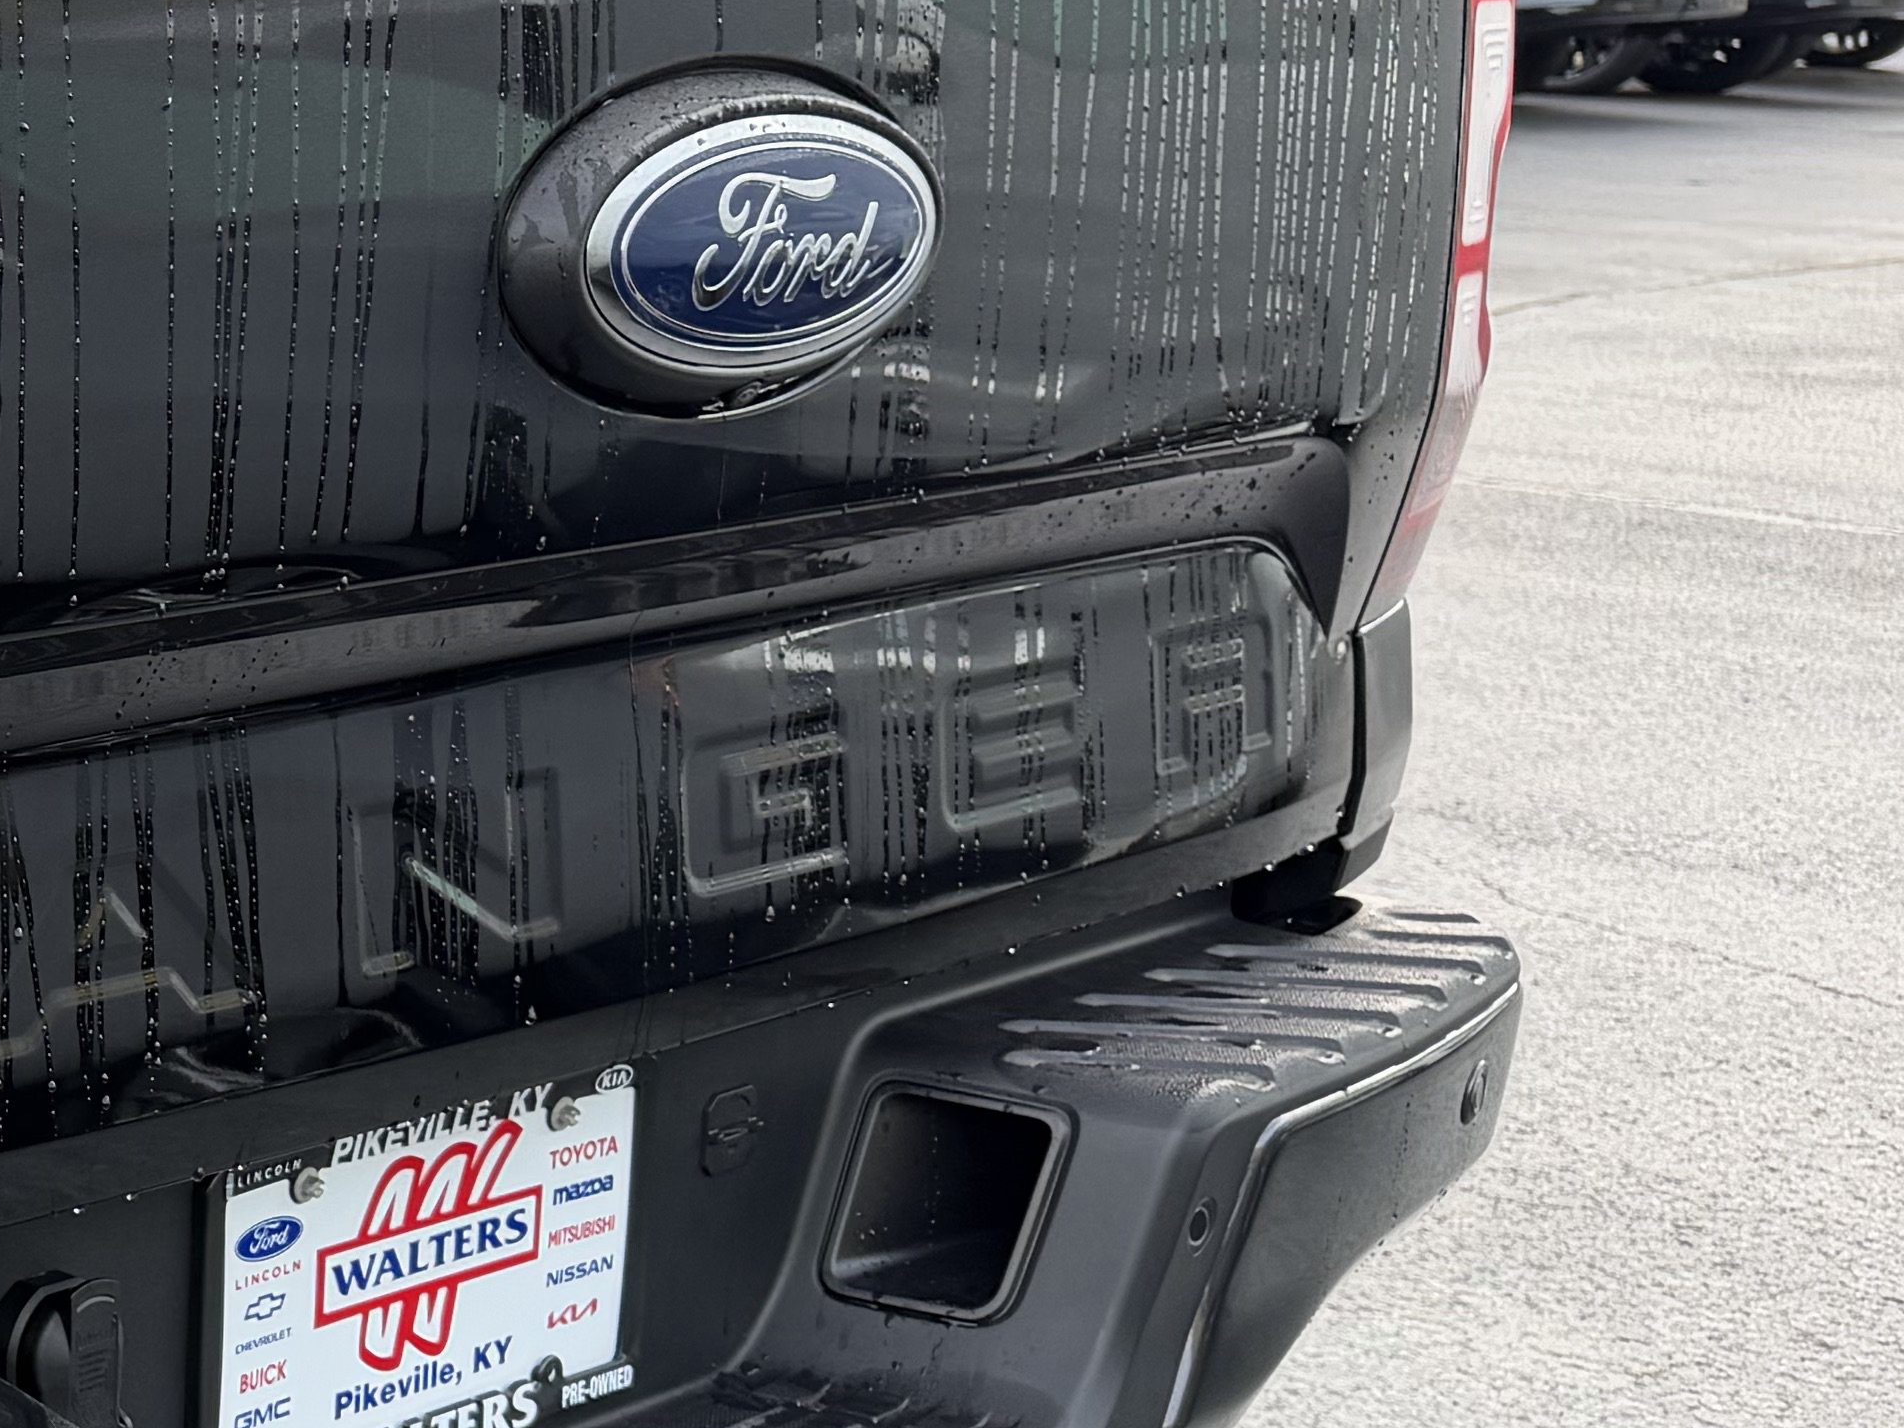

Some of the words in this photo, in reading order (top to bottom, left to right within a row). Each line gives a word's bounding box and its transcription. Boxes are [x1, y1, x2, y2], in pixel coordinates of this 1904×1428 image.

[692, 171, 905, 311] Ford
[601, 1069, 629, 1089] KIA
[508, 1082, 554, 1121] KY
[549, 1135, 618, 1170] TOYOTA
[237, 1158, 302, 1188] LINCOLN
[249, 1222, 290, 1254] Ford
[547, 1214, 616, 1249] MITSUBISHI
[331, 1207, 528, 1296] WALTERS
[235, 1260, 302, 1291] LINCOLN
[546, 1254, 614, 1289] NISSAN
[235, 1327, 292, 1355] CHEVROLET
[239, 1359, 288, 1395] BUICK
[334, 1359, 463, 1420] Pikeville,
[472, 1335, 513, 1373] KY
[561, 1364, 635, 1409] PRE-OWNED
